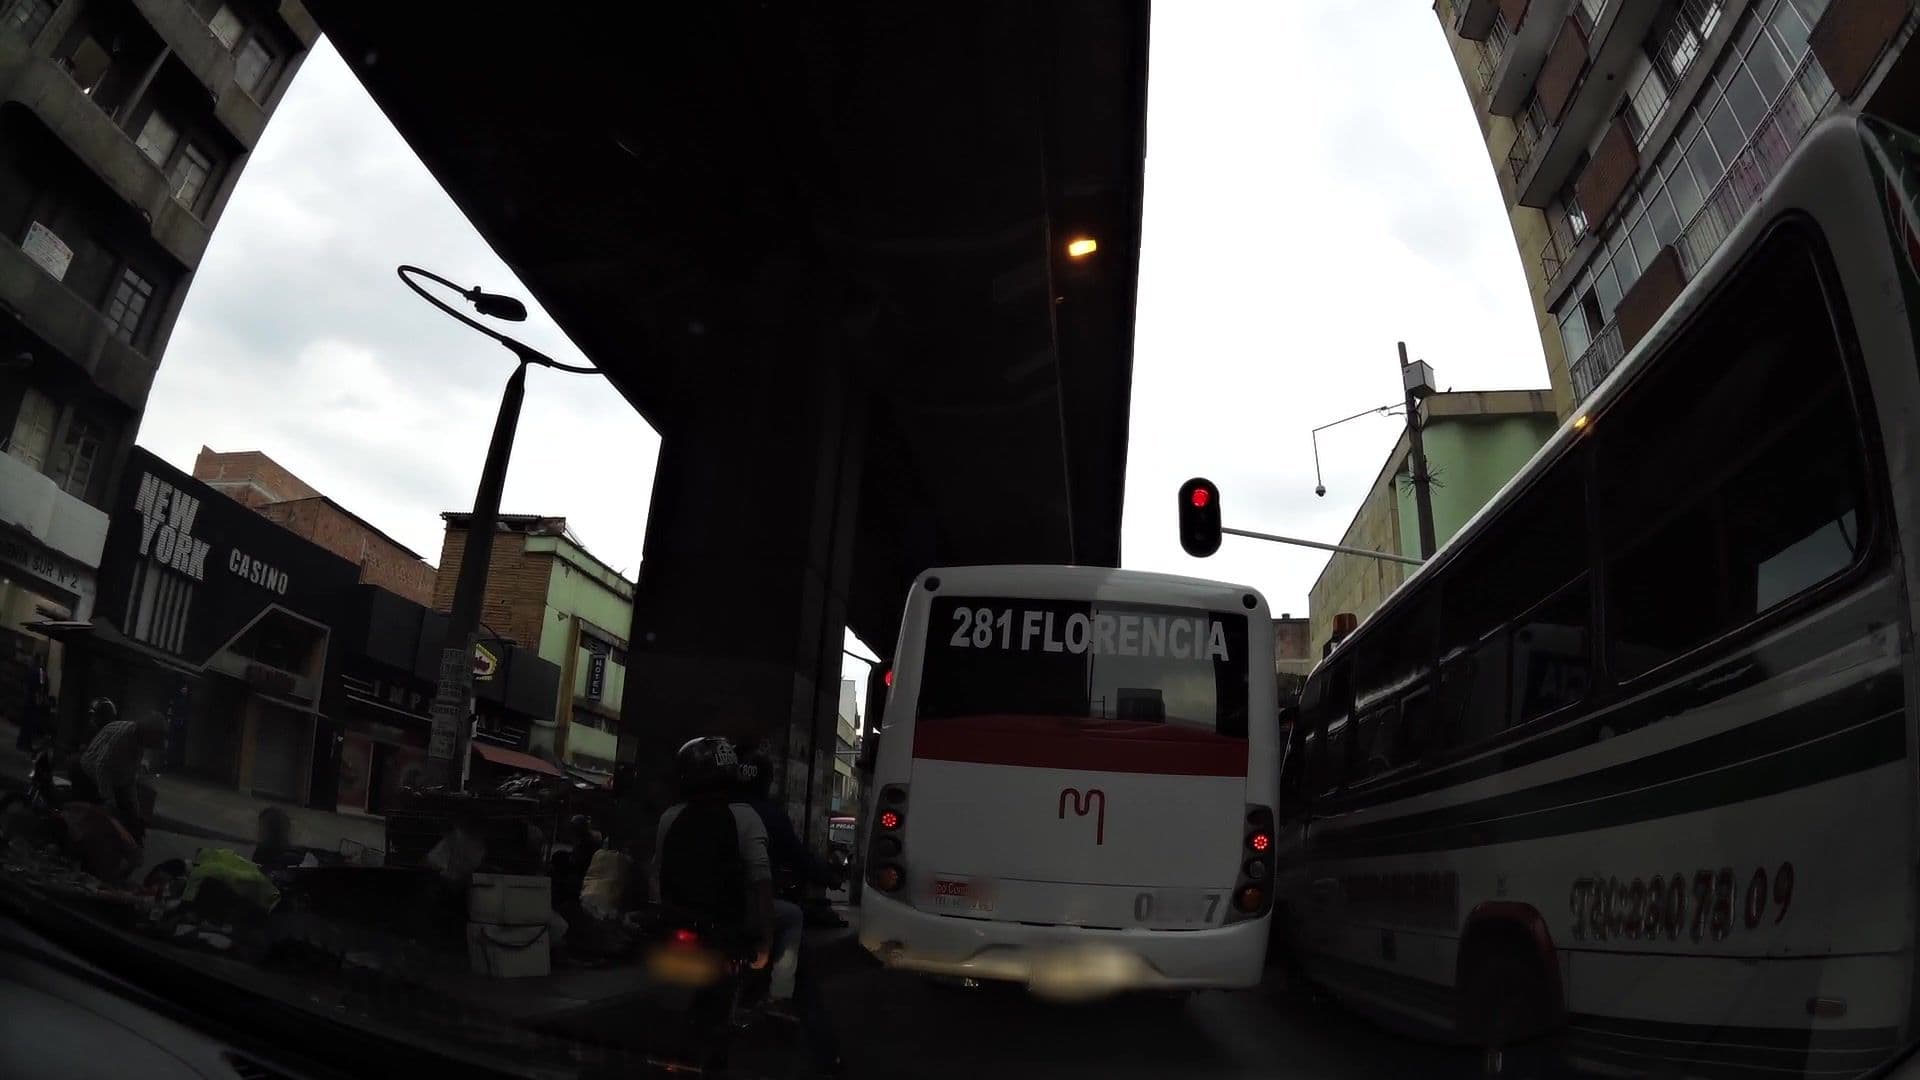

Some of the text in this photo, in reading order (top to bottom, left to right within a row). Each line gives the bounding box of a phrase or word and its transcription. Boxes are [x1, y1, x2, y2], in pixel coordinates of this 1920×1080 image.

[134, 472, 200, 534] NEW
[139, 511, 211, 581] YORK
[229, 547, 288, 595] CASINO
[950, 606, 1230, 662] 281 FLORENCIA
[1134, 892, 1221, 923] 07
